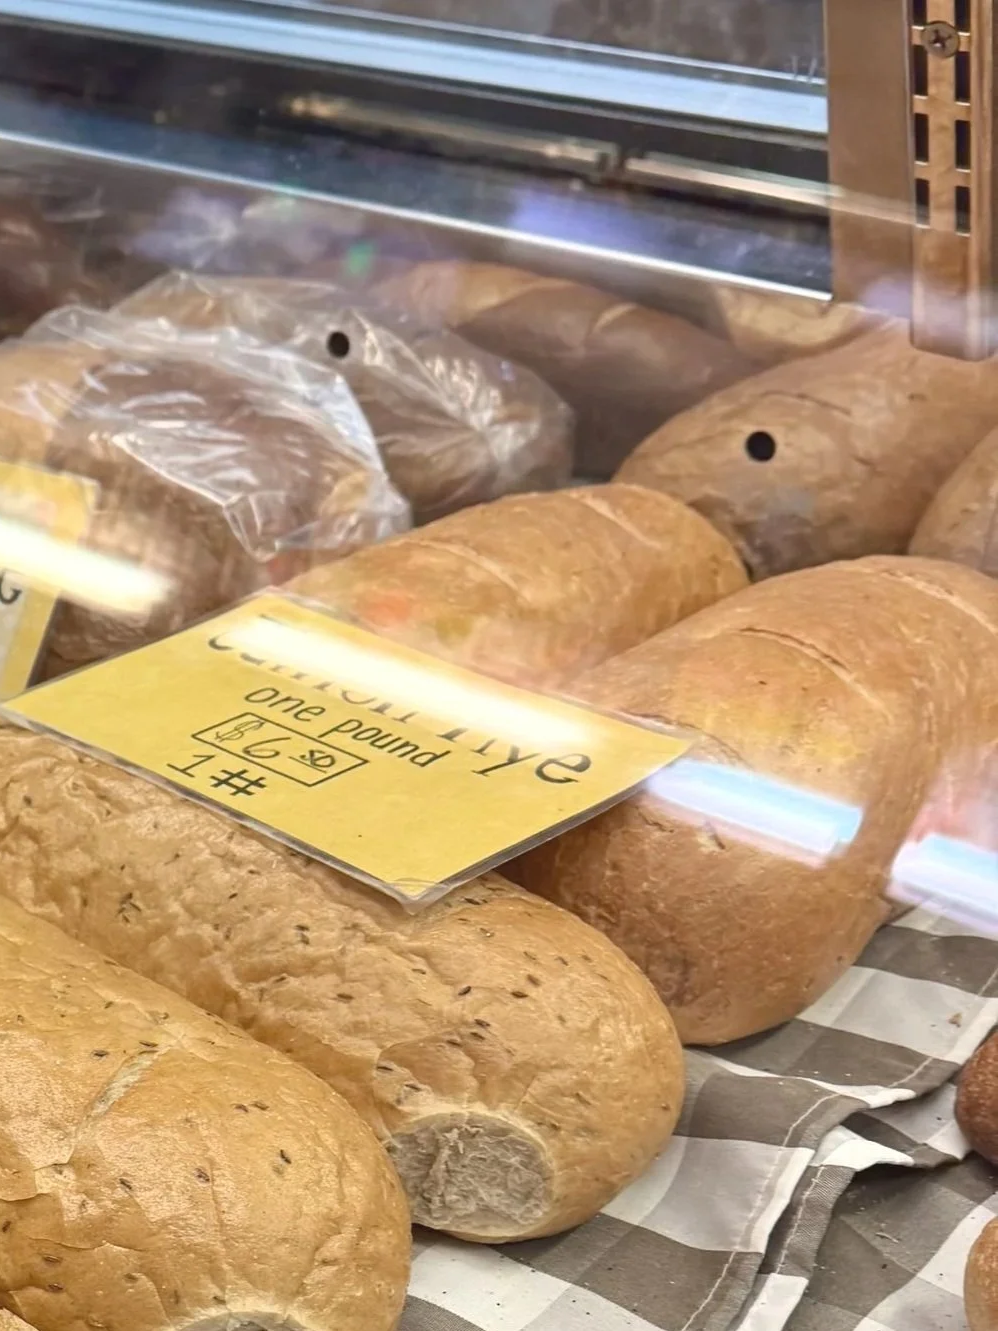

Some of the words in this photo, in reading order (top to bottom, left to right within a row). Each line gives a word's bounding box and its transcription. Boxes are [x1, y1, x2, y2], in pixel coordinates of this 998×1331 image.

[244, 686, 326, 723] one
[317, 718, 451, 768] pound
[436, 727, 592, 784] ye
